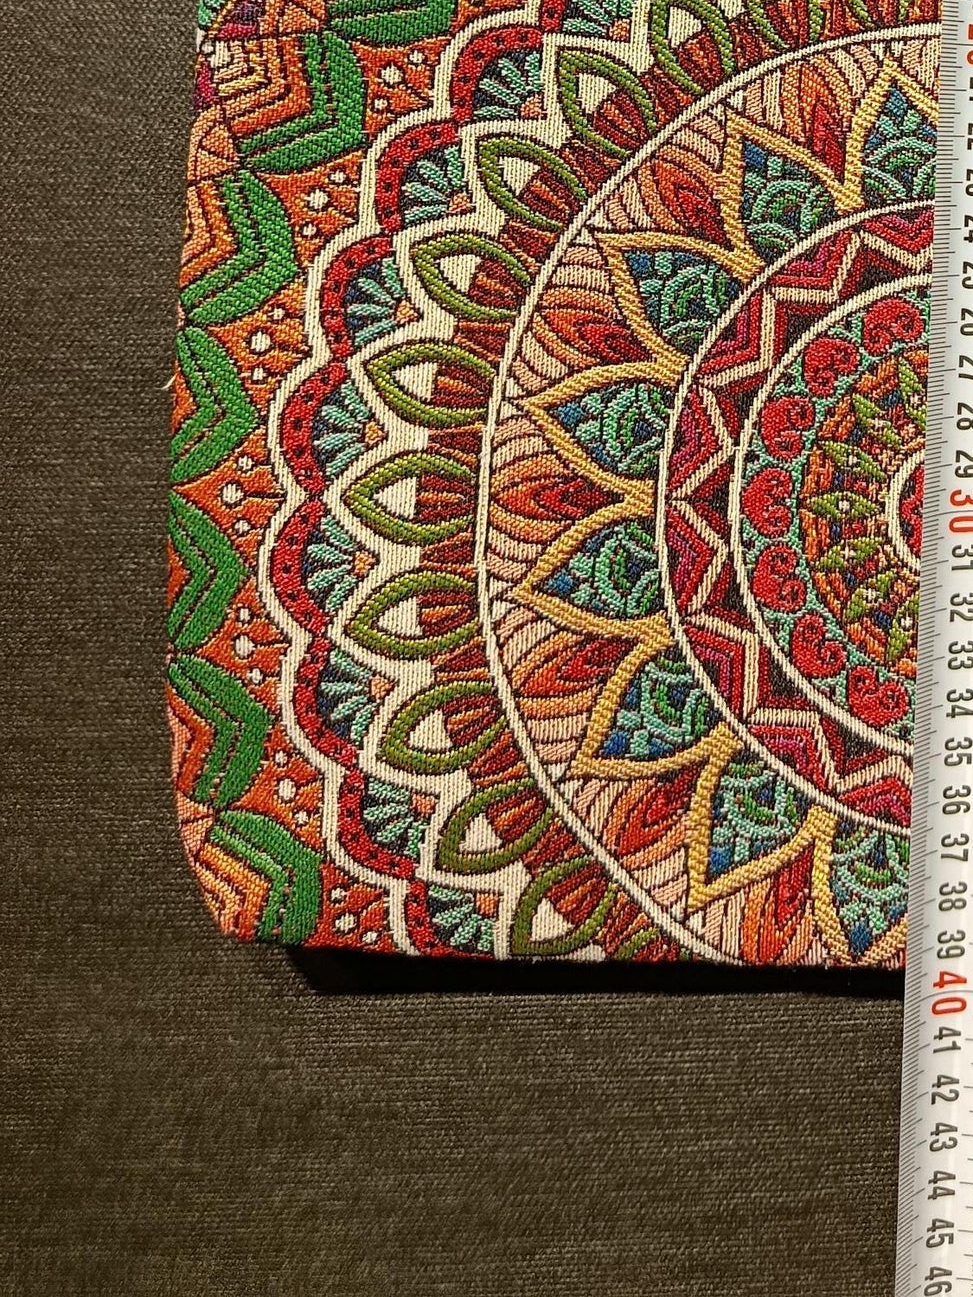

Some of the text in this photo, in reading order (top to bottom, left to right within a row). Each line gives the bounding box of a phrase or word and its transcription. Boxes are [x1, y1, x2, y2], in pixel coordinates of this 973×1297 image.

[946, 689, 973, 718] 34
[944, 737, 972, 766] 35
[942, 785, 971, 815] 36
[941, 834, 969, 861] 37
[939, 882, 967, 911] 38
[937, 930, 965, 959] 39
[932, 971, 967, 1015] 40
[933, 1027, 961, 1053] 41
[931, 1075, 959, 1105] 42
[929, 1123, 957, 1152] 43
[928, 1171, 955, 1200] 44
[926, 1219, 954, 1248] 45
[924, 1267, 952, 1296] 46
